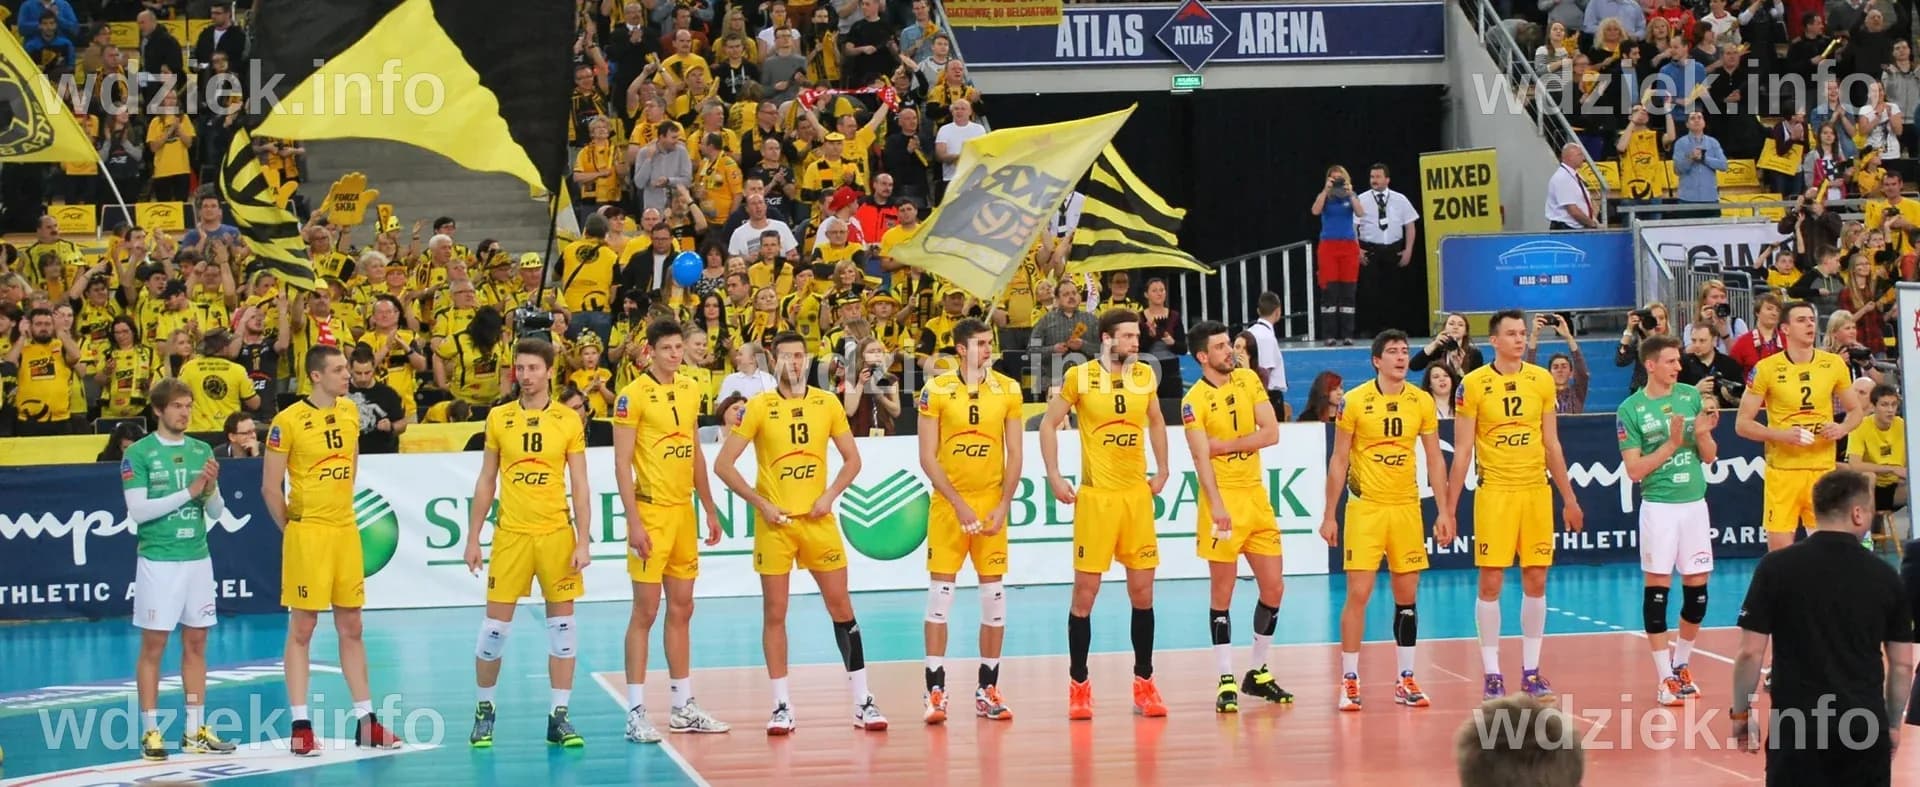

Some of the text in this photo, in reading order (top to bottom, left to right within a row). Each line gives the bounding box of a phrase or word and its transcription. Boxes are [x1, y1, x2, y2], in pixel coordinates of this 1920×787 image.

[1055, 10, 1329, 58] ATLAS ARENA
[1174, 25, 1214, 46] ATLAS
[1426, 163, 1491, 191] MIXED
[1433, 195, 1489, 221] ZONE
[1114, 394, 1127, 415] 8
[1502, 396, 1523, 417] 12
[1800, 386, 1812, 406] 2
[671, 405, 680, 427] 1
[968, 404, 980, 426] 6
[1228, 410, 1239, 432] 7
[789, 422, 809, 445] 13
[1382, 417, 1404, 438] 10
[323, 428, 344, 450] 15
[521, 432, 543, 453] 18
[1102, 432, 1139, 447] PGE
[1494, 432, 1531, 448] PGE
[663, 444, 692, 460] PGE
[952, 443, 991, 458] PGE
[1372, 453, 1408, 467] PGE
[1661, 451, 1693, 471] PGE
[174, 467, 187, 490] 17
[319, 466, 350, 481] PGE
[512, 471, 550, 486] PGE
[780, 463, 817, 481] PGE
[1077, 545, 1085, 559] 8
[1479, 542, 1489, 556] 12
[297, 585, 308, 599] 15
